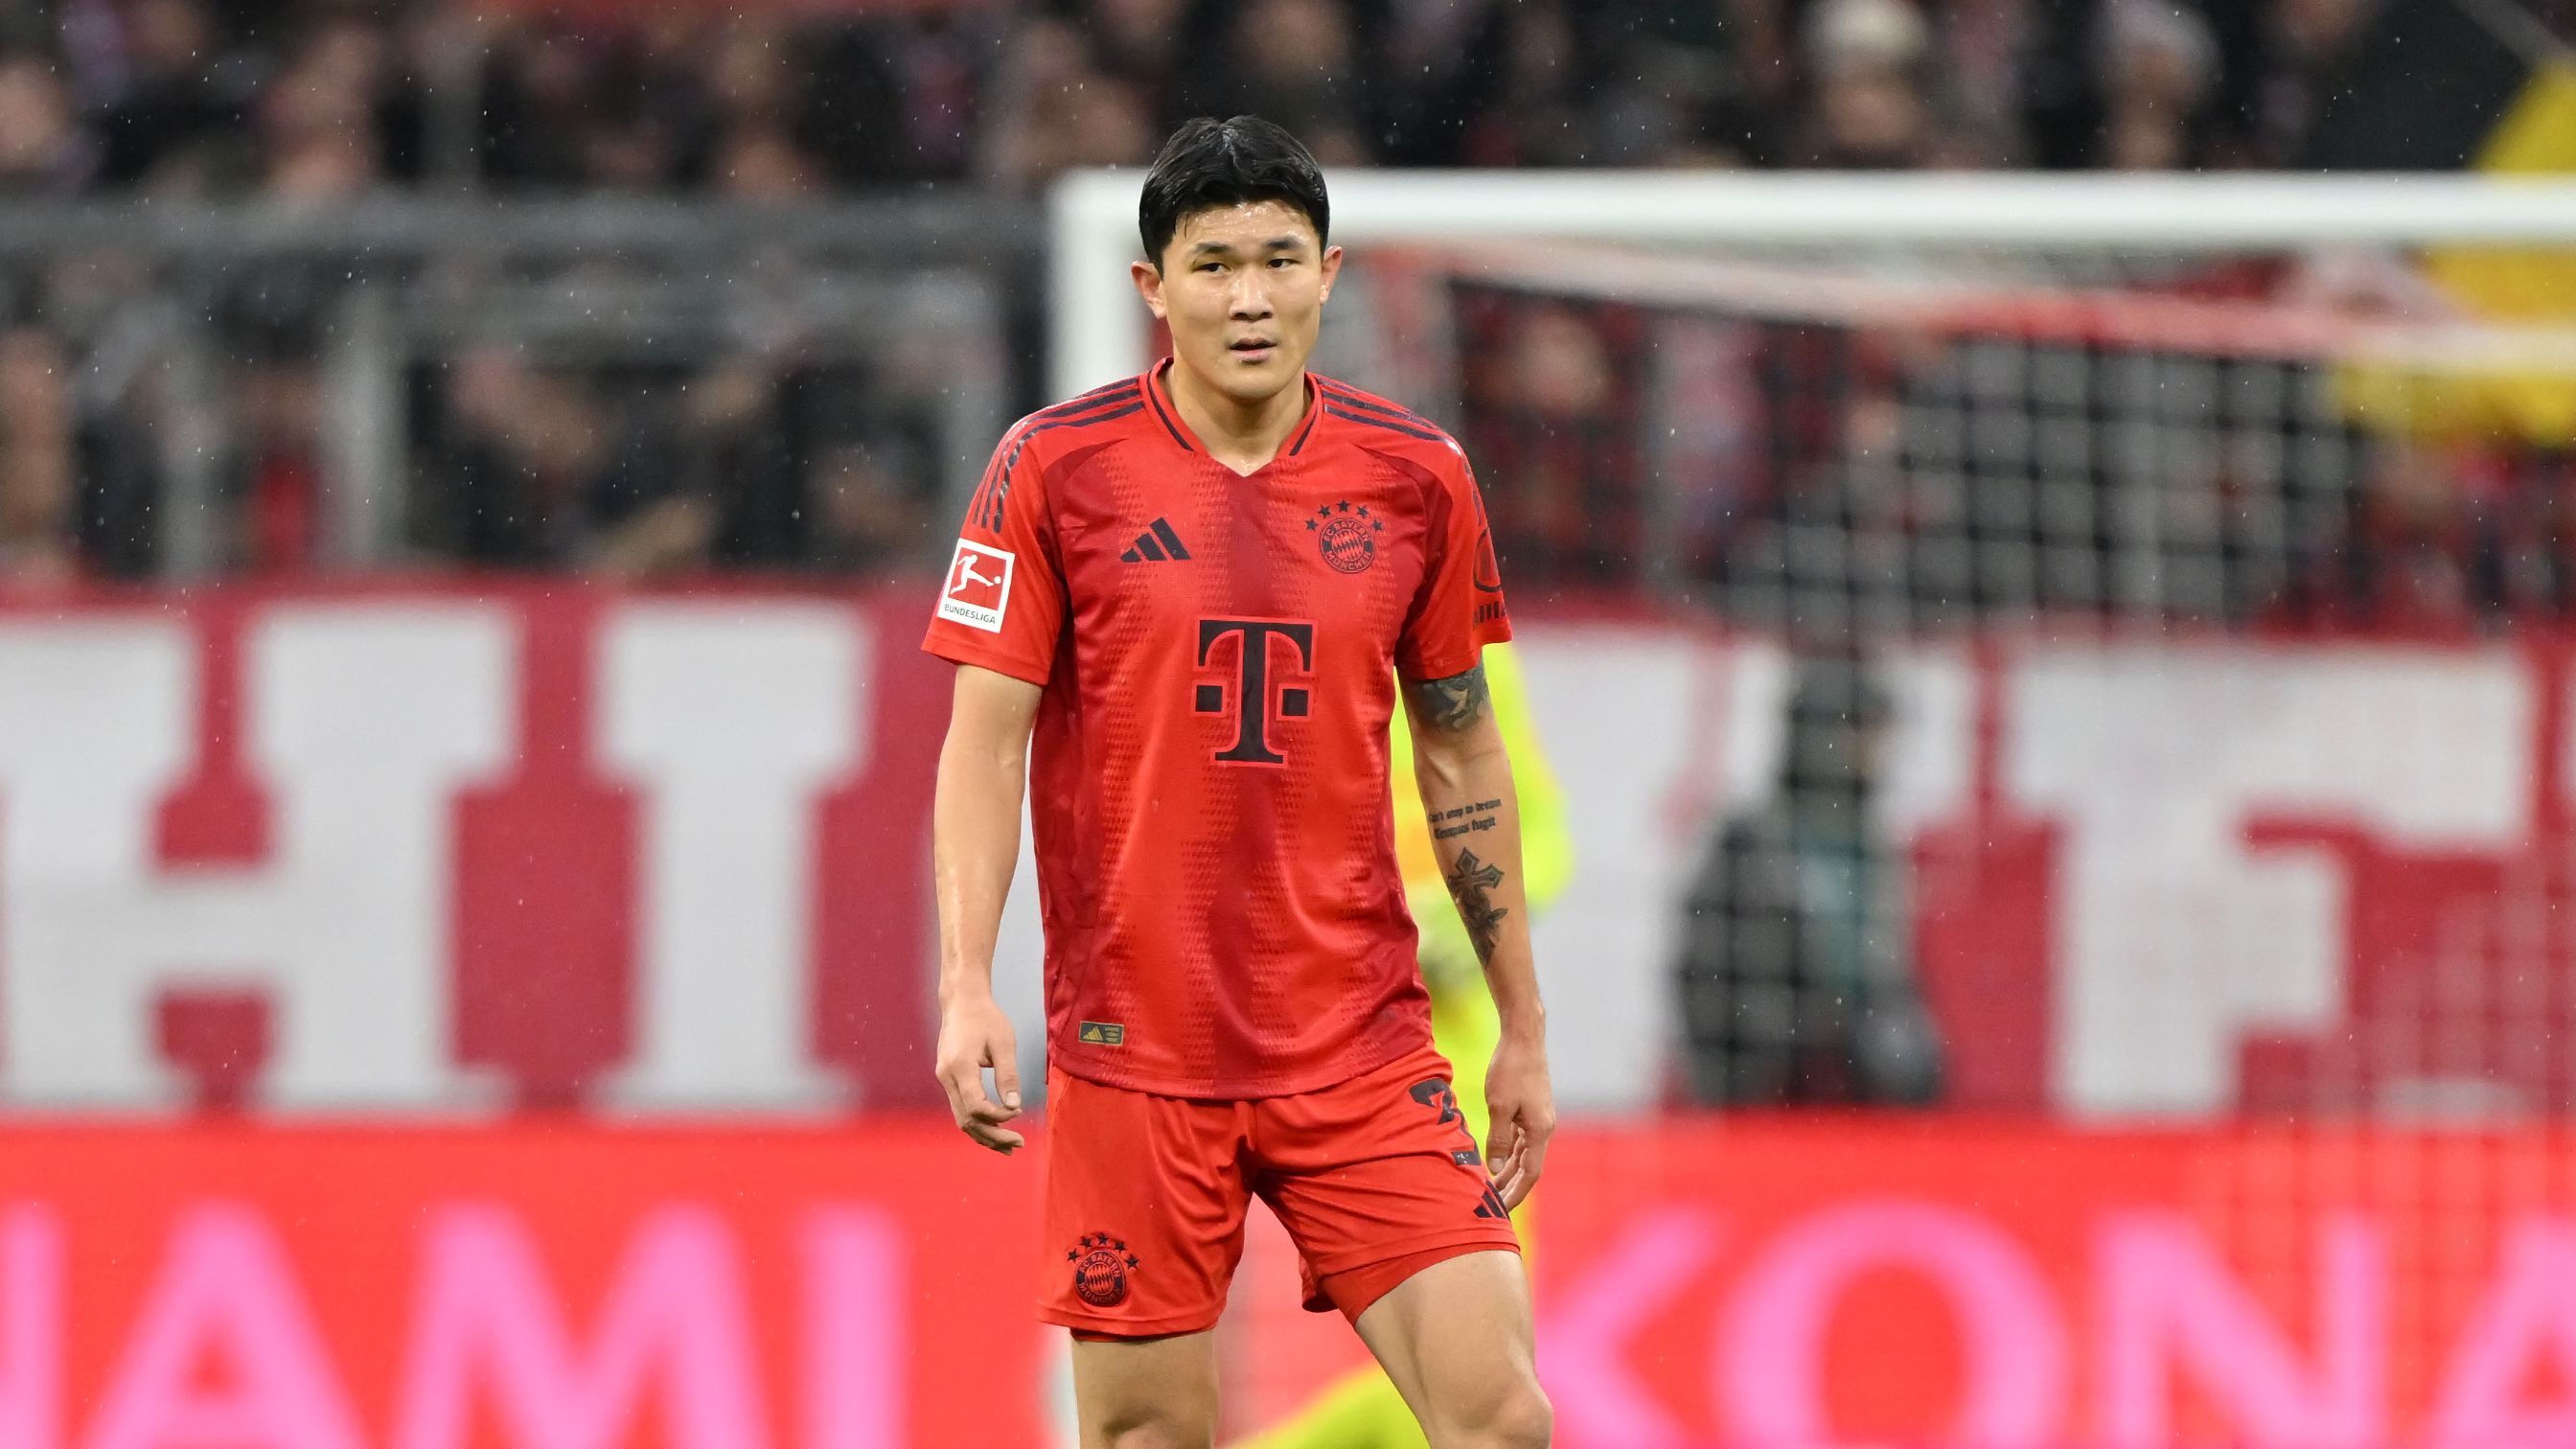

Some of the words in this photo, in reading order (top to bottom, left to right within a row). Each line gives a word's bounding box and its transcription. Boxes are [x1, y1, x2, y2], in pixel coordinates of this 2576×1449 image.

[1333, 520, 1370, 542] BAYERN
[944, 603, 997, 624] BUNDESLIGA
[1195, 619, 1313, 765] T
[1091, 1253, 1121, 1277] BAYERN
[0, 1198, 906, 1449] AMI
